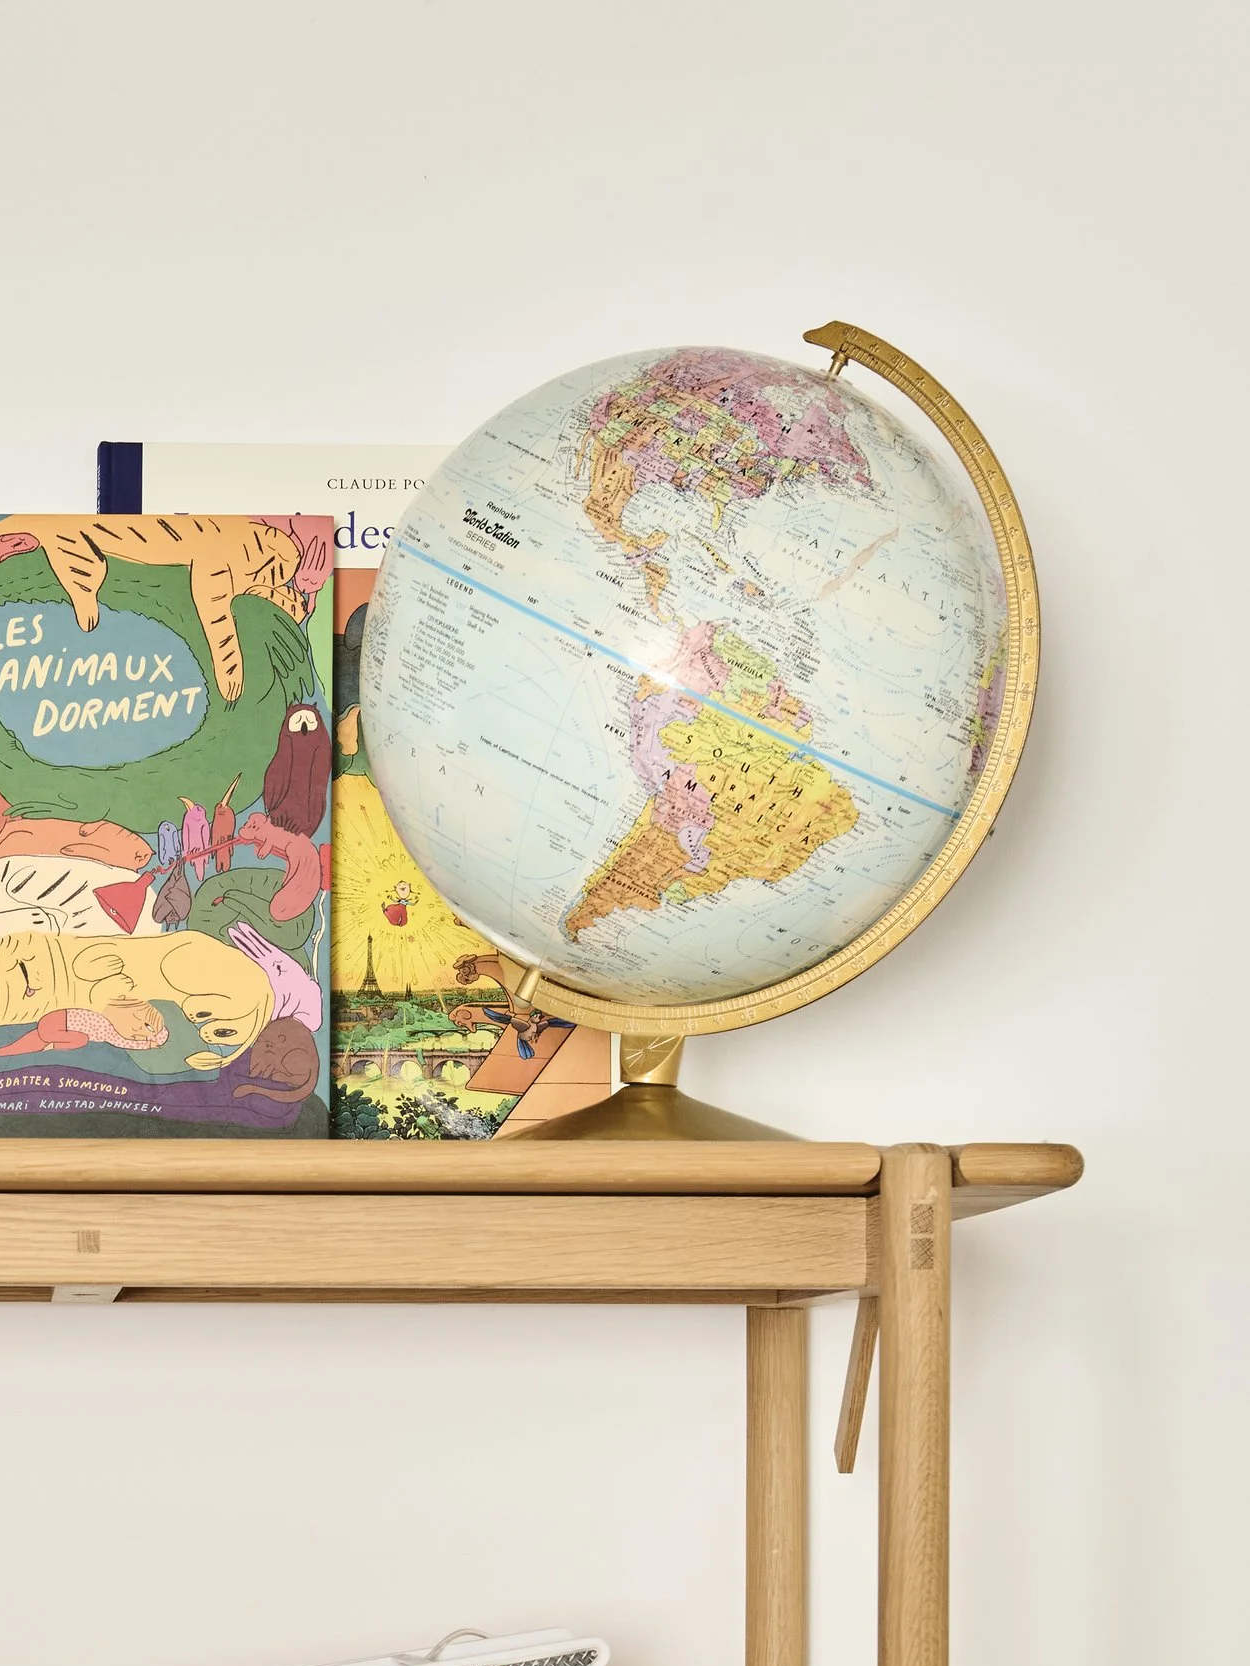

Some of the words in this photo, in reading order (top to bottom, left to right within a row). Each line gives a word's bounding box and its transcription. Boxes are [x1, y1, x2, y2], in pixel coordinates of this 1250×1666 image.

[326, 478, 397, 491] CLAUDE
[463, 508, 488, 532] World
[485, 520, 521, 549] Nation
[465, 530, 497, 552] SERIES
[446, 576, 474, 595] LEGEND
[595, 570, 624, 588] CENTRAL
[616, 602, 649, 622] AMERICA
[606, 663, 635, 681] ECUADOR
[699, 650, 720, 687] COLOMBIA
[726, 657, 764, 680] VENEZUELA
[33, 686, 203, 737] DORMENT
[604, 723, 626, 738] PERU
[605, 875, 651, 900] ARGENTINA
[57, 1078, 128, 1096] SKOMSVOLD
[38, 1099, 94, 1110] KANSTAD
[99, 1099, 163, 1114] JOHNSEN
